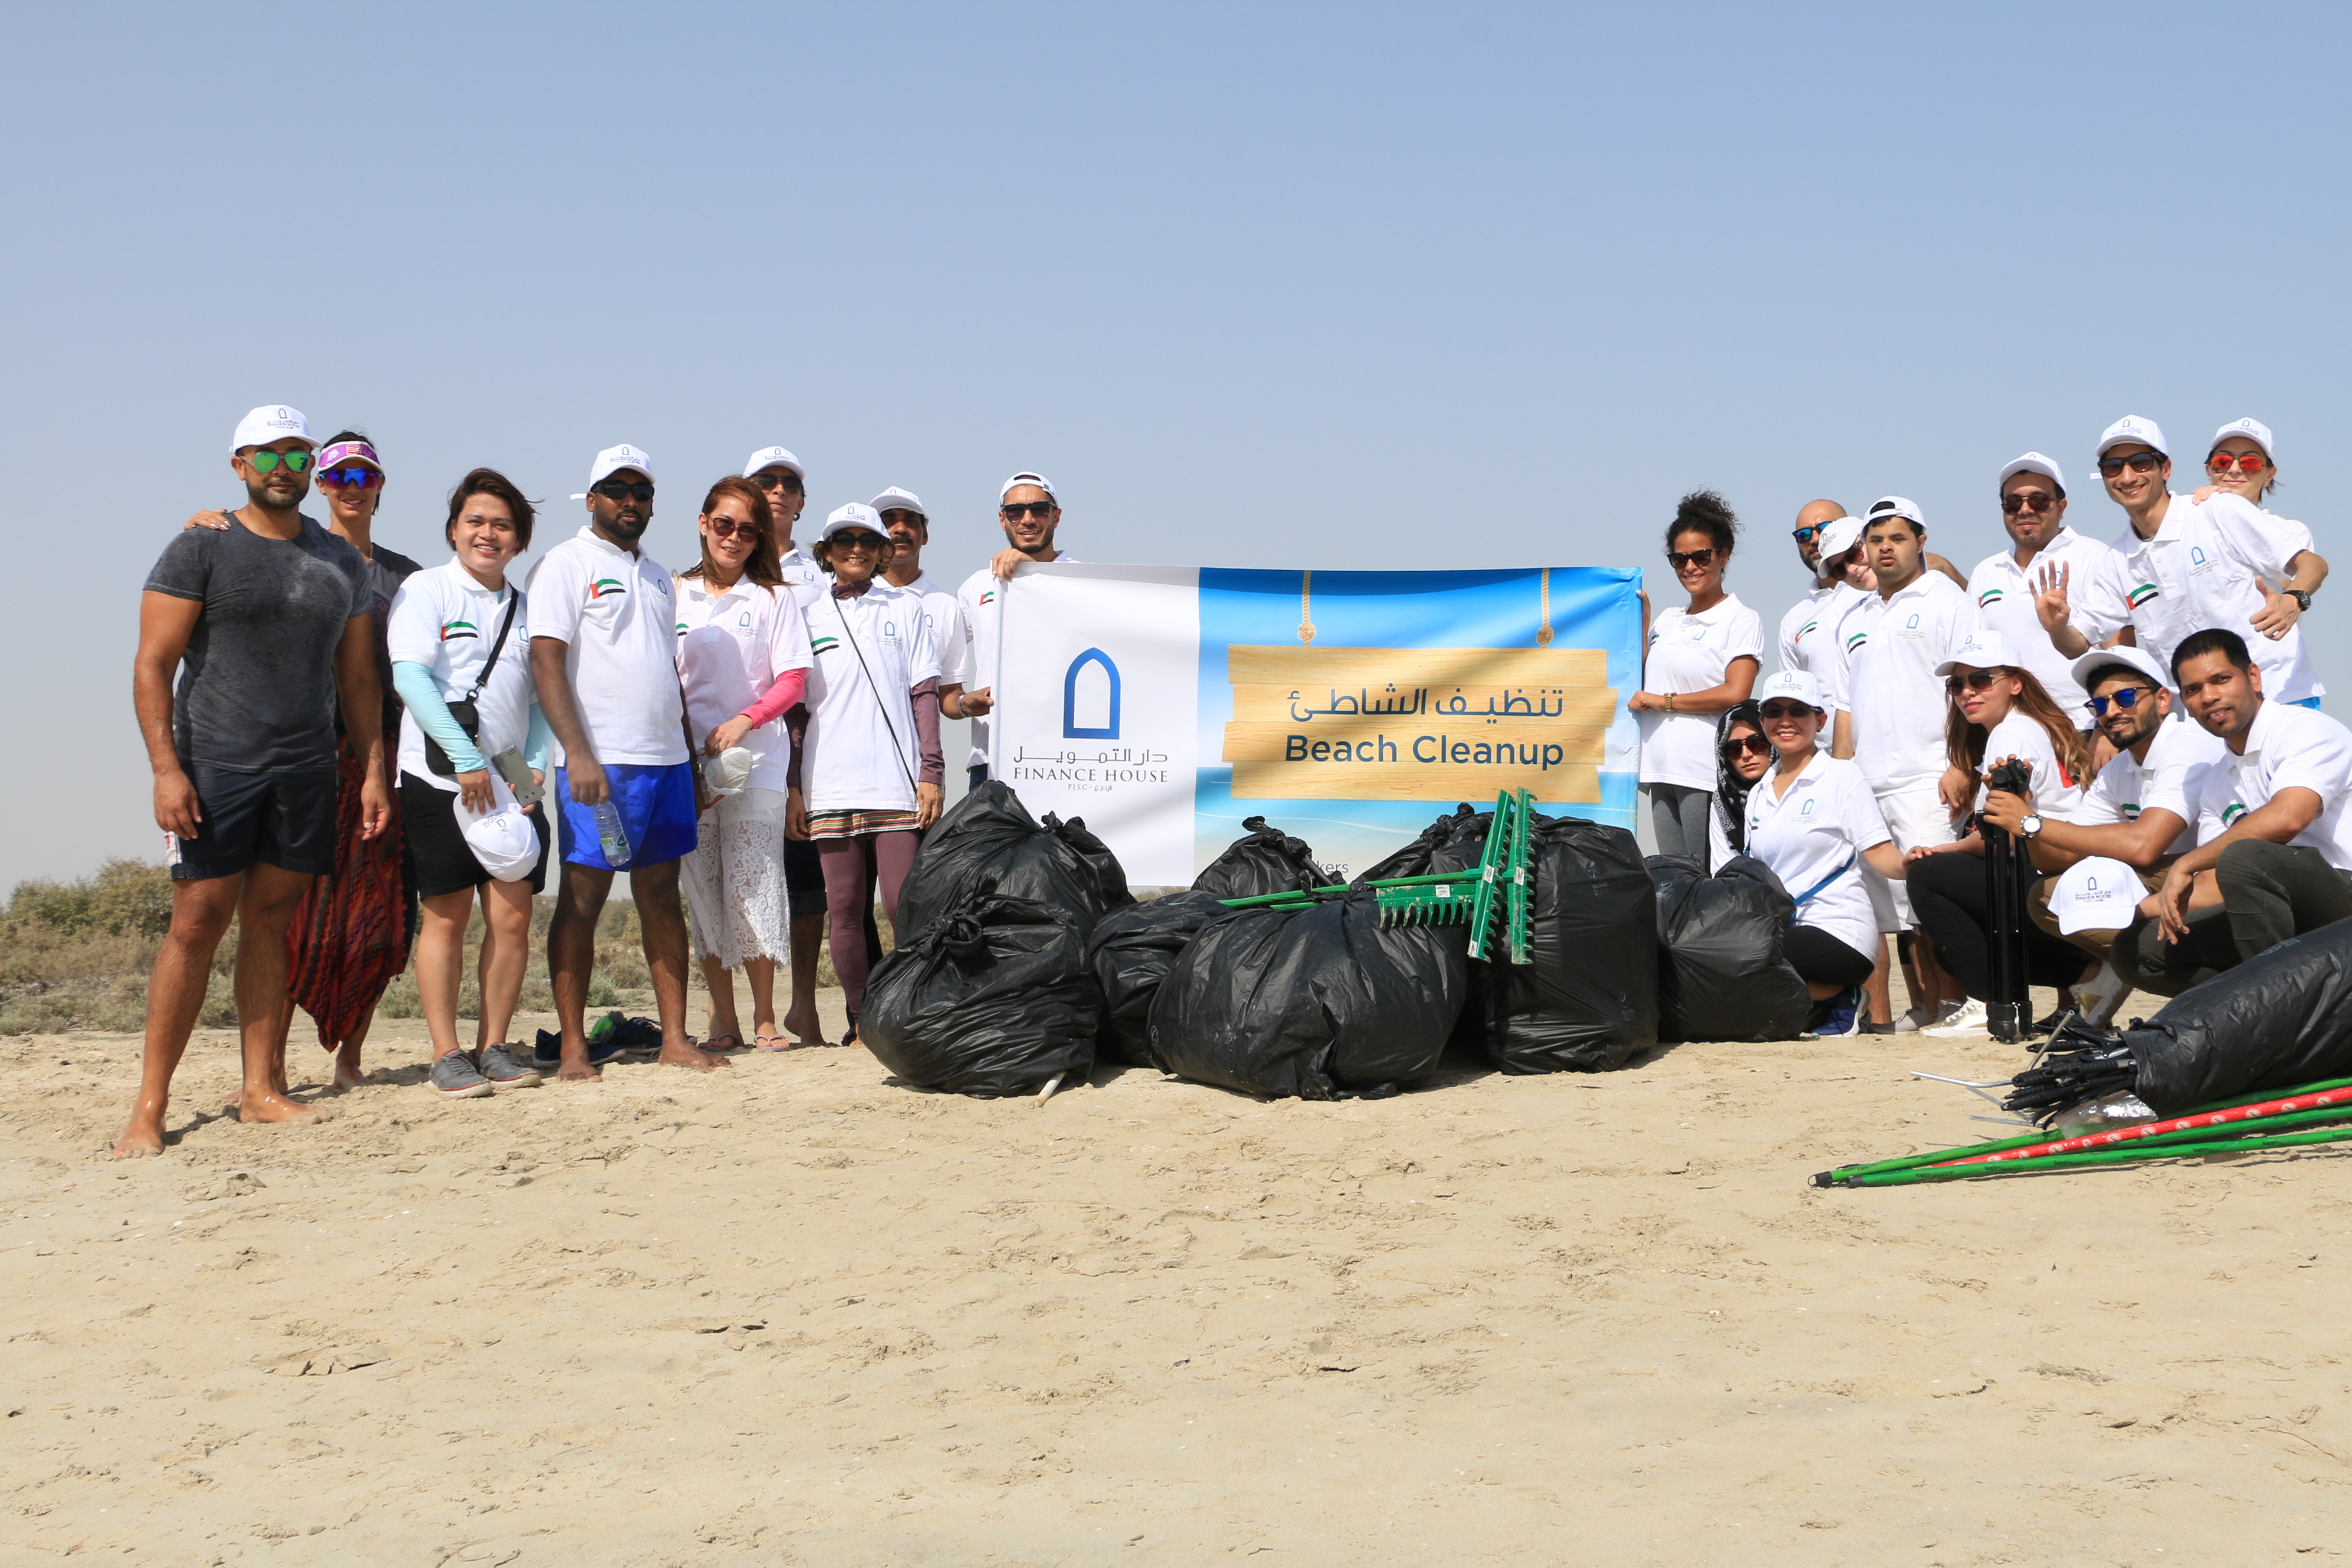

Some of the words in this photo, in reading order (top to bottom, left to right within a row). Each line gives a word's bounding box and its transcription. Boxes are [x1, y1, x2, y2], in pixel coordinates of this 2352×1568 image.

[1286, 682, 1427, 722] الشاطئ
[1435, 687, 1563, 724] تنظيف
[1013, 745, 1132, 765] التمويل
[1132, 749, 1168, 766] دار
[1285, 734, 1398, 763] Beach
[1412, 735, 1564, 770] Cleanup
[1013, 767, 1097, 781] FINANCE
[1104, 769, 1168, 783] HOUSE
